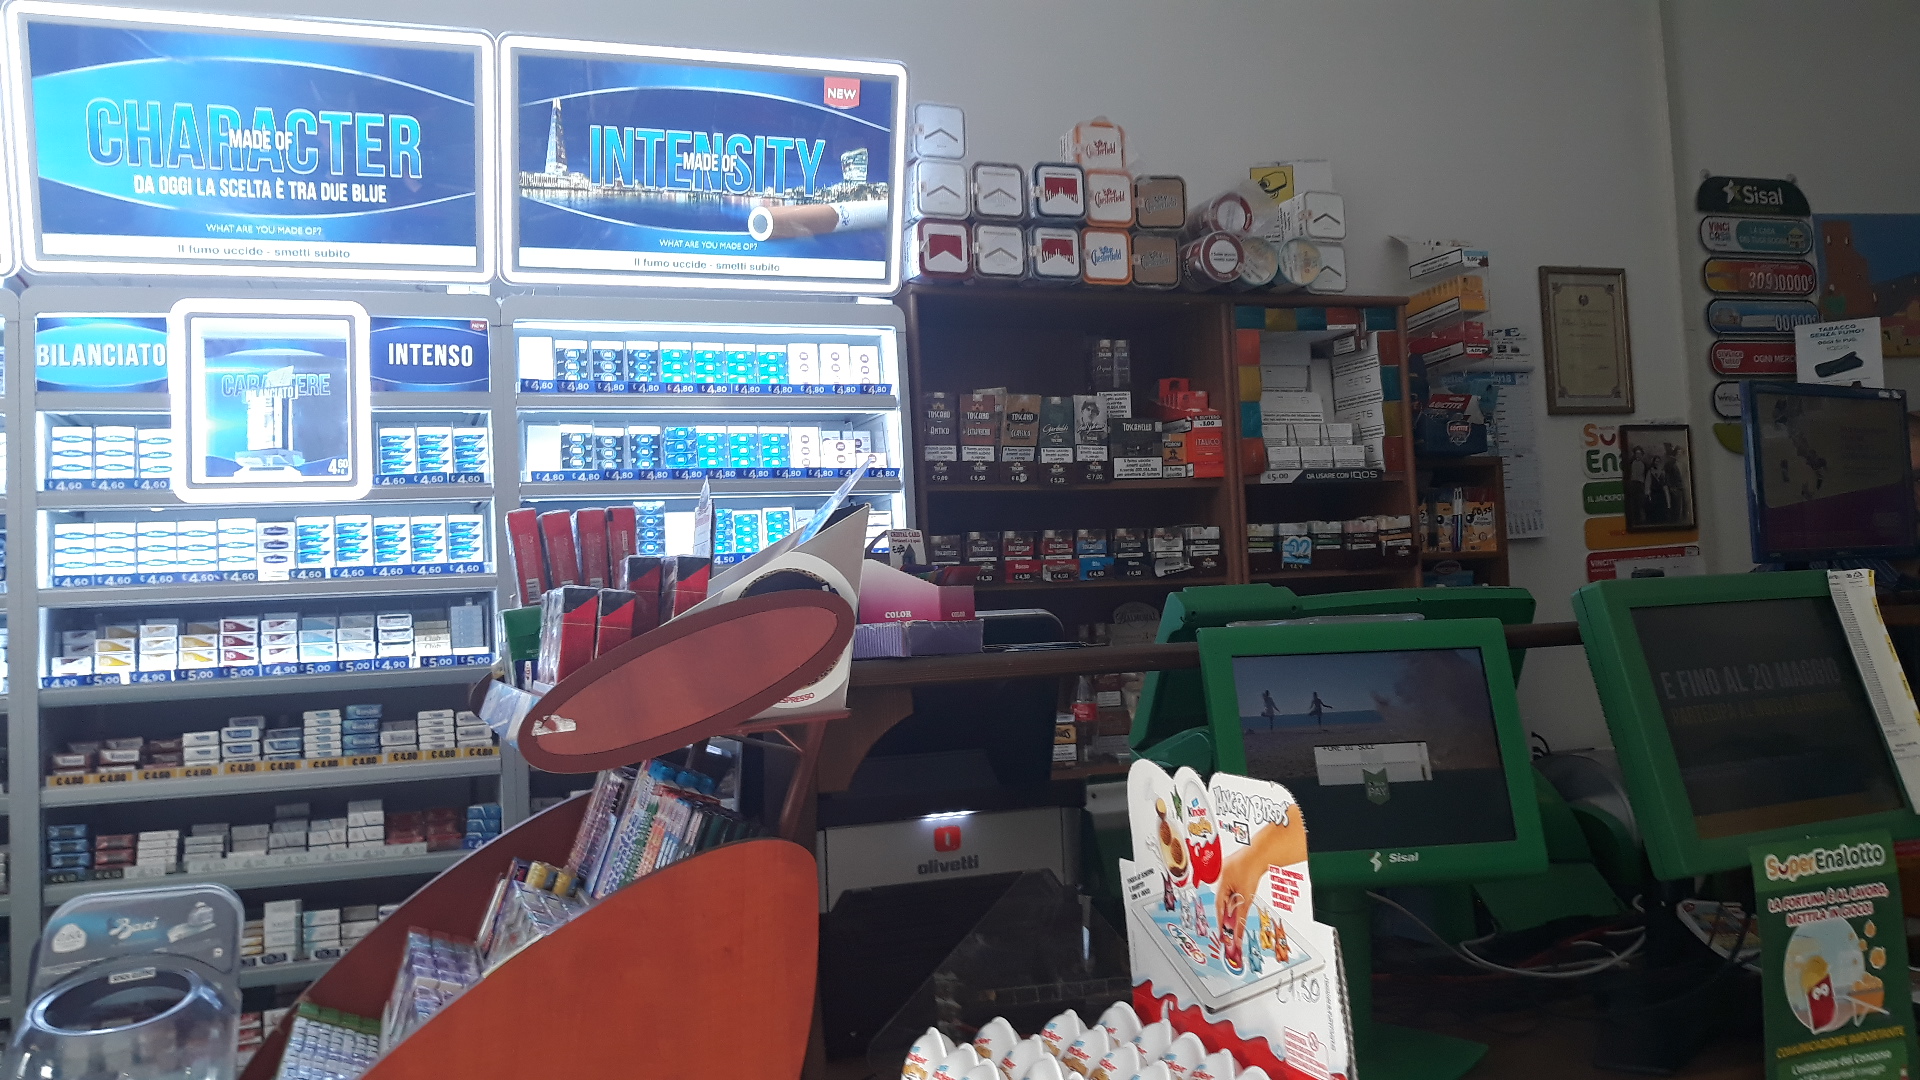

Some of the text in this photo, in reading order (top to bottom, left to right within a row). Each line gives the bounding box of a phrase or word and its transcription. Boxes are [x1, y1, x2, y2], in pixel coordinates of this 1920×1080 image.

[827, 86, 857, 100] NEW
[85, 98, 423, 180] CHARACTER
[229, 128, 294, 151] MADE OF
[590, 125, 826, 198] INTENSITY
[683, 151, 738, 173] MADE OF
[134, 174, 388, 204] DA OGGI LA SCELTA È TRA DUE BLUE
[1742, 185, 1784, 206] Sisal
[206, 223, 323, 237] WHAT ARE YOU MADE OF?
[187, 244, 220, 255] fumo
[223, 246, 264, 257] uccide
[274, 247, 312, 258] smetti
[314, 248, 351, 260] subito
[659, 239, 759, 252] WHAT ARE YOU MADE OF?
[643, 258, 670, 268] fumo
[673, 258, 707, 269] uccide
[716, 260, 748, 271] smetti
[749, 261, 781, 273] subito
[1091, 248, 1123, 266] Chesterfield
[1818, 324, 1857, 332] TABACCO
[36, 341, 168, 368] BILANCIATO
[387, 343, 474, 368] INTENSO
[1195, 438, 1221, 447] ITALICO
[1350, 471, 1378, 480] IQOS
[884, 610, 912, 619] COLOR
[1660, 656, 1841, 700] E FINO AL 20 MAGGIO
[1213, 786, 1292, 827] ANGRY BIRDS
[917, 854, 980, 875] olivetti
[1388, 851, 1420, 865] Sisal
[1766, 844, 1884, 880] SuperEnalotto
[1782, 891, 1827, 911] FORTUNA
